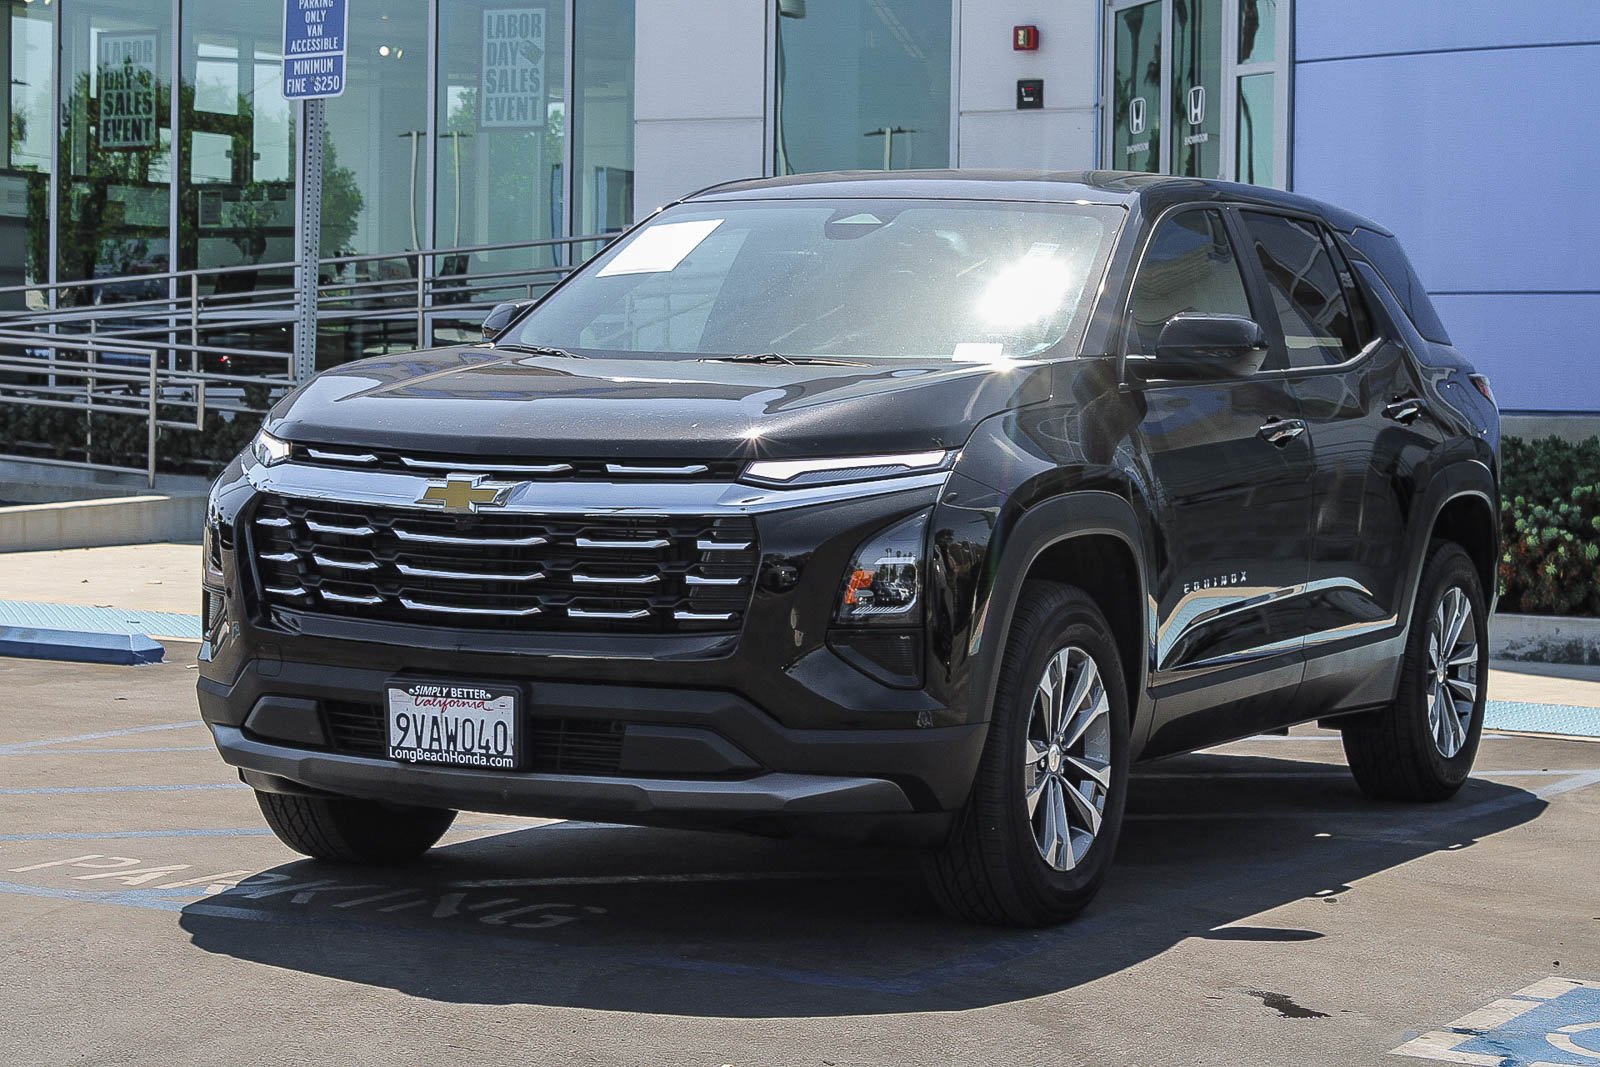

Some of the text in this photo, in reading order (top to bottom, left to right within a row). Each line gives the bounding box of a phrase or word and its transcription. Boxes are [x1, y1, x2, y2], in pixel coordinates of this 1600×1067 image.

[299, 0, 333, 9] PARKING
[305, 10, 326, 23] ONLY
[487, 13, 542, 39] LABOR
[307, 24, 323, 37] VAN
[104, 40, 153, 65] LABOR
[290, 37, 338, 53] ACCESSIBLE
[487, 41, 519, 66] DAY
[293, 58, 334, 75] MINIMUM
[286, 75, 340, 94] FINE $250
[486, 67, 540, 94] SALES
[103, 91, 153, 116] SALES
[485, 95, 540, 121] EVENT
[102, 118, 153, 142] EVENT
[1183, 571, 1247, 594] EQUINOX
[414, 685, 486, 699] SIMPLY BETTER
[414, 696, 494, 713] California
[395, 712, 508, 755] 9VAW040
[389, 746, 513, 768] LongBeachHonda.com
[8, 855, 607, 928] PARKING
